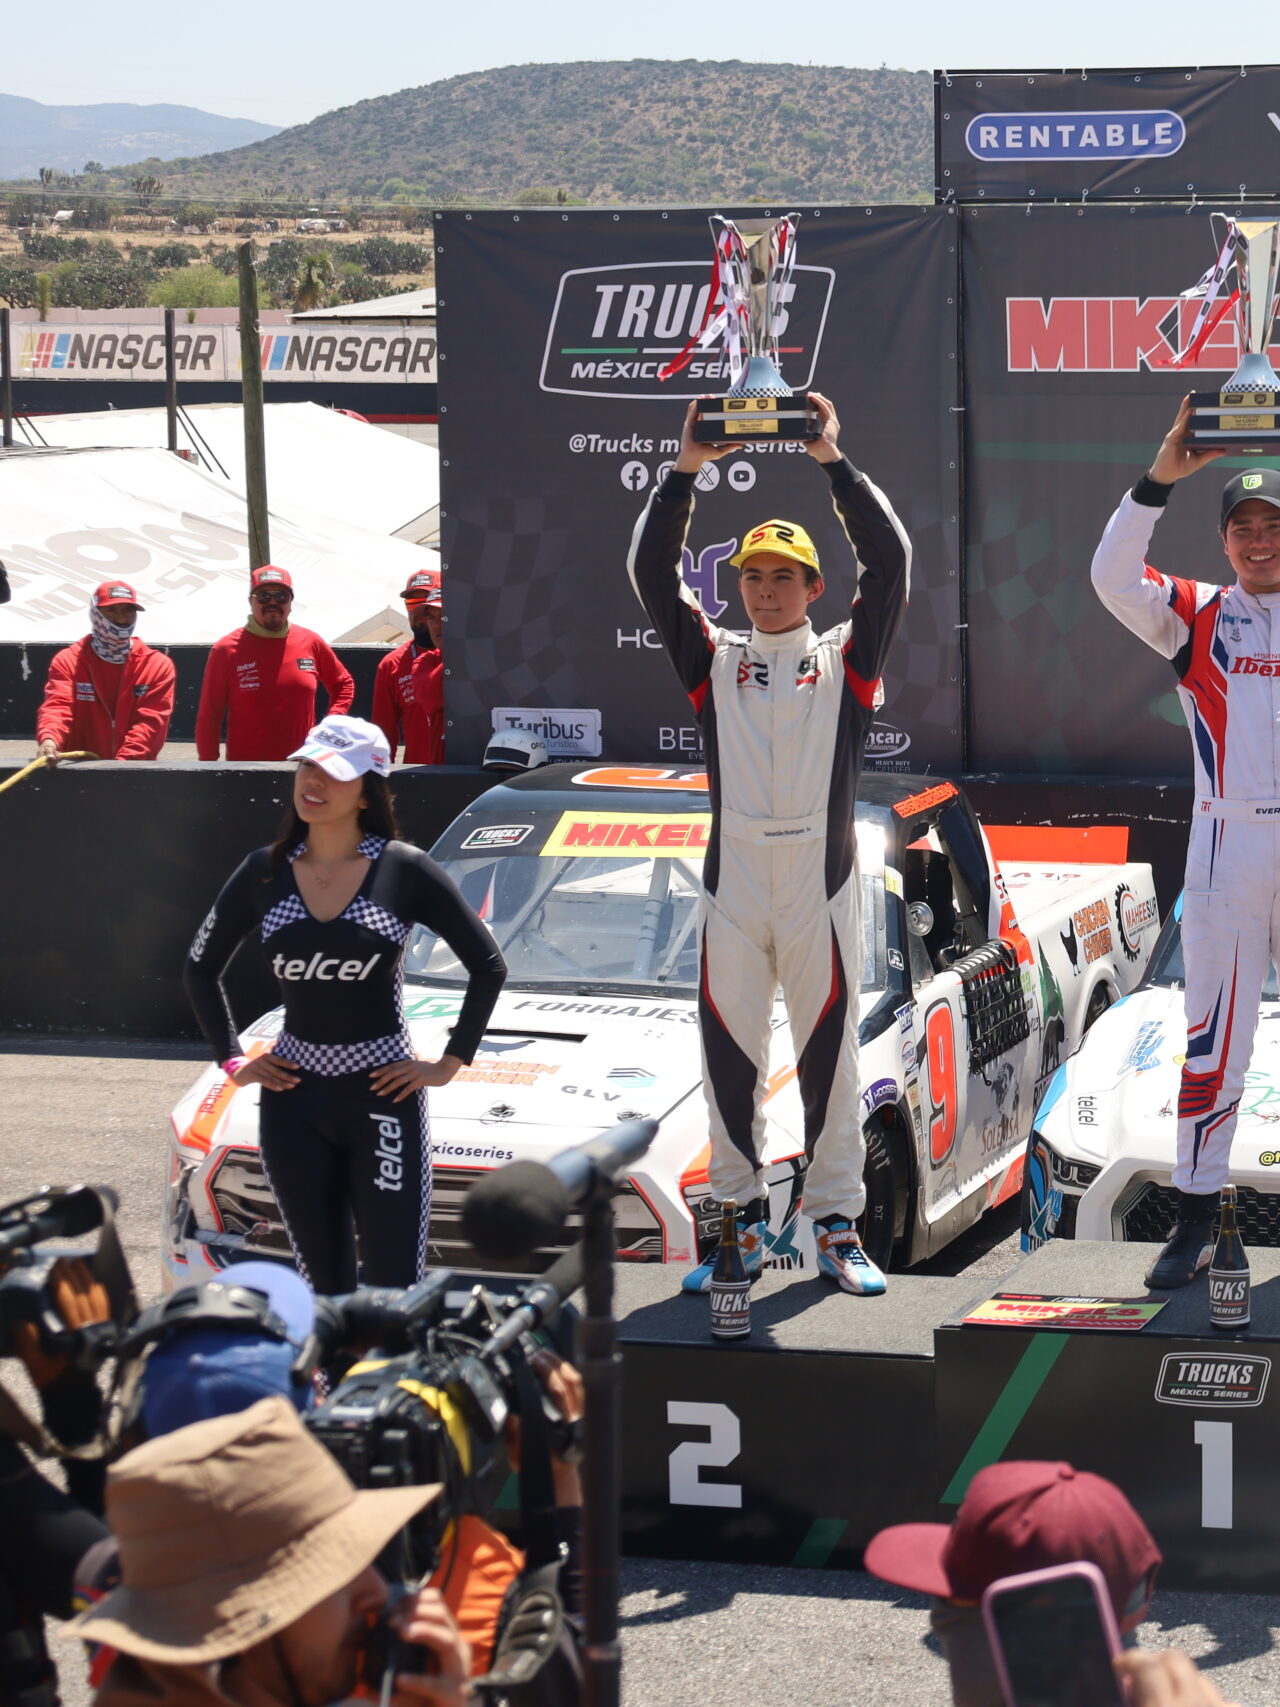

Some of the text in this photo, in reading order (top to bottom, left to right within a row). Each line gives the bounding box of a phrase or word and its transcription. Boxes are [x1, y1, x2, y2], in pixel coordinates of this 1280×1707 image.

[979, 121, 1173, 149] RENTABLE
[69, 333, 218, 371] NASCAR
[284, 335, 438, 374] NASCAR
[568, 432, 654, 455] @Trucks
[314, 729, 355, 749] telcel
[476, 828, 524, 840] TRUCKS
[188, 905, 218, 963] telcel
[271, 951, 381, 982] telcel
[560, 1084, 622, 1102] GLV
[924, 996, 958, 1172] 9
[1077, 1095, 1099, 1127] telcel
[373, 1113, 404, 1192] telcel
[1213, 1306, 1243, 1315] SERIES
[1177, 1362, 1255, 1385] TRUCKS
[1170, 1385, 1250, 1399] MÉXICO SERIES
[666, 1400, 743, 1509] 2
[1194, 1419, 1233, 1530] 1
